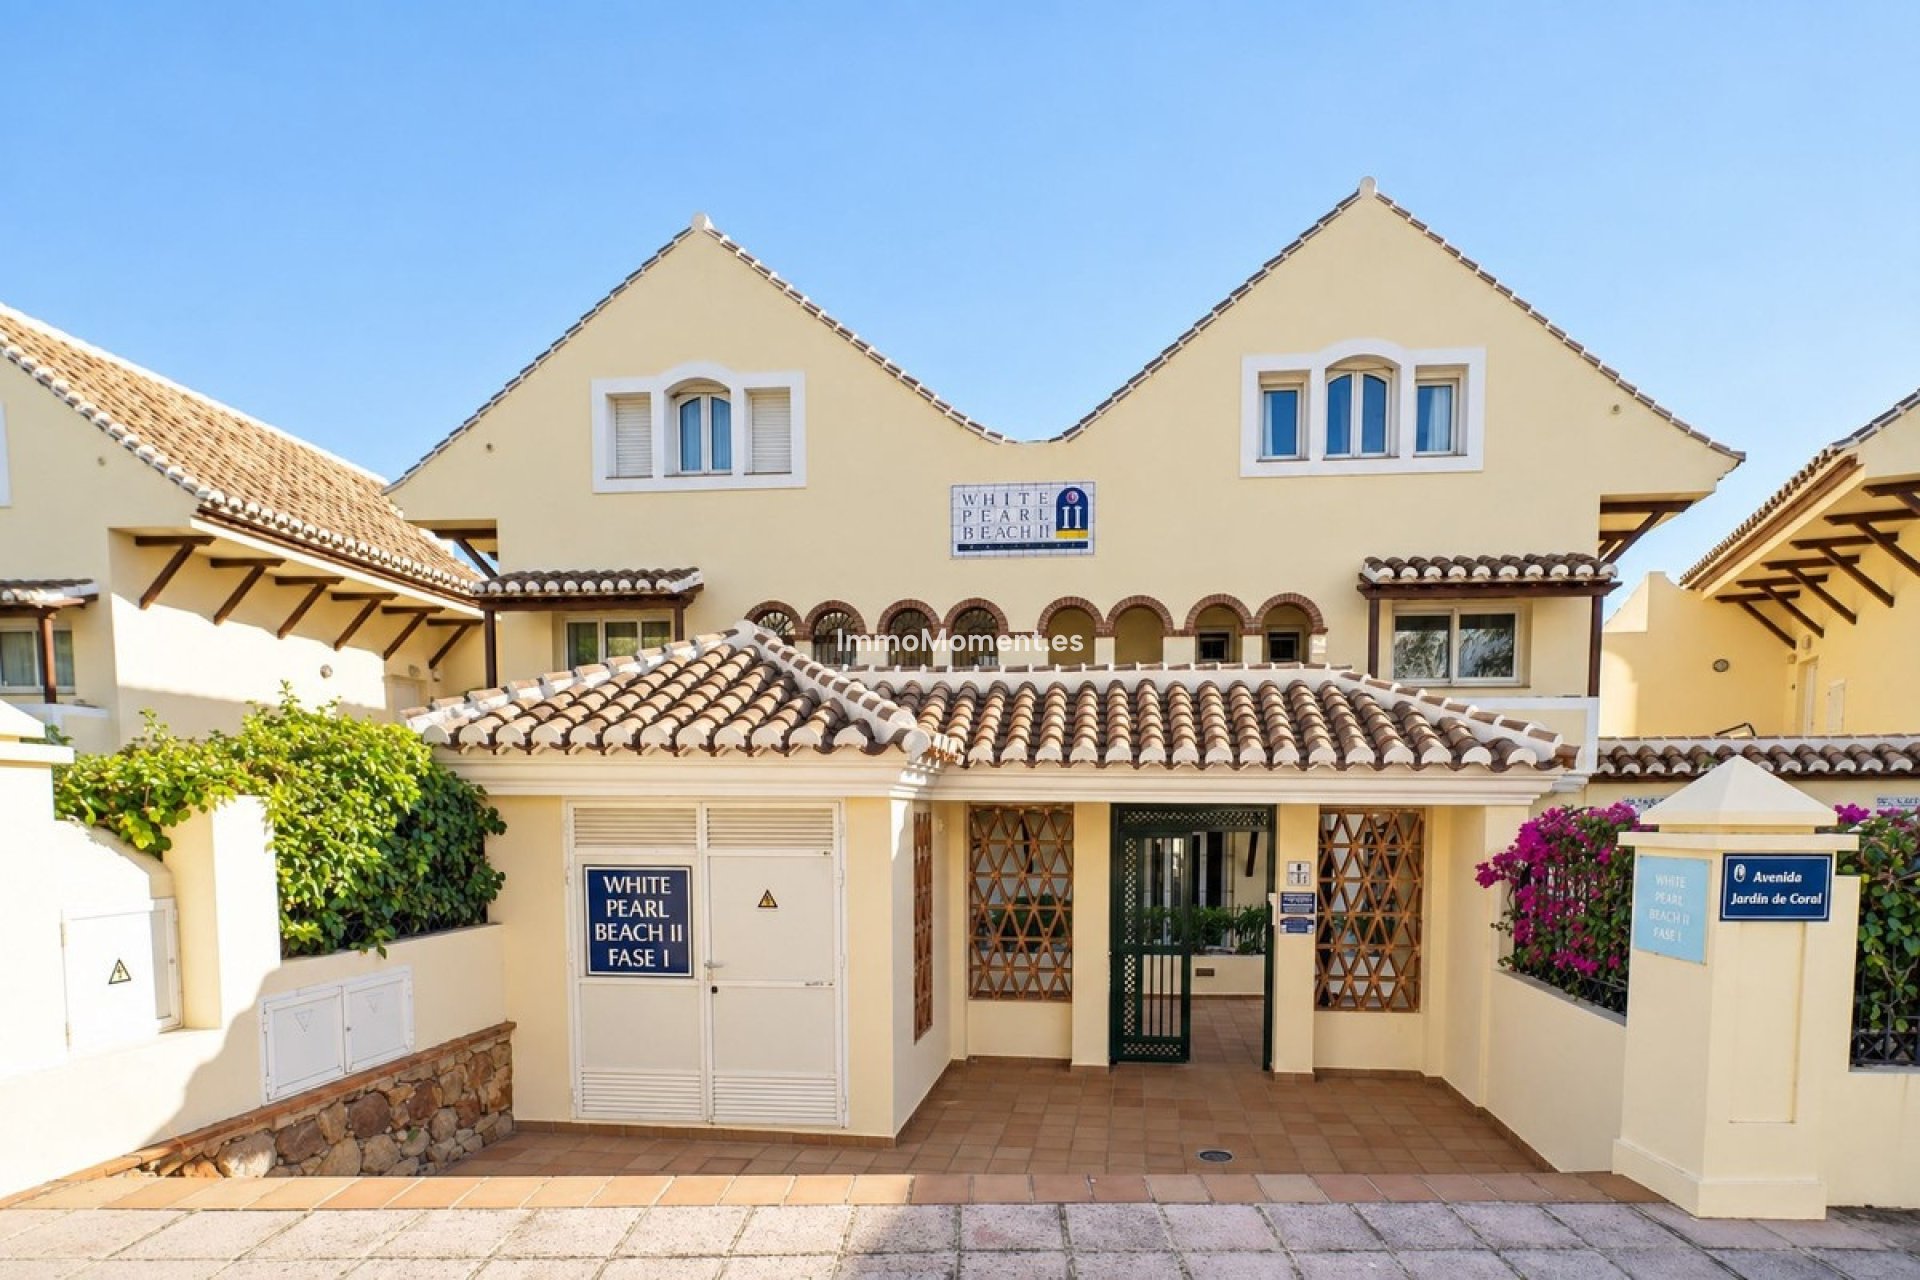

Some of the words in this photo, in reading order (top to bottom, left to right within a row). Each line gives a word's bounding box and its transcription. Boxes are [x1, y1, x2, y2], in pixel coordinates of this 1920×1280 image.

[962, 492, 1049, 506] WHITE
[962, 508, 1049, 523] PEARL
[963, 525, 1031, 540] BEACH
[1039, 524, 1049, 538] II
[603, 876, 672, 894] WHITE
[1655, 874, 1687, 889] WHITE
[1753, 871, 1803, 883] Avenida
[1654, 891, 1684, 907] PEARL
[1772, 892, 1787, 905] de
[1789, 892, 1823, 905] Coral
[606, 899, 670, 918] PEARL
[1649, 908, 1681, 925] BEACH
[595, 923, 663, 942] BEACH
[671, 924, 683, 942] II
[1652, 926, 1676, 941] FASE
[608, 948, 656, 967] FASE
[663, 949, 670, 968] I
